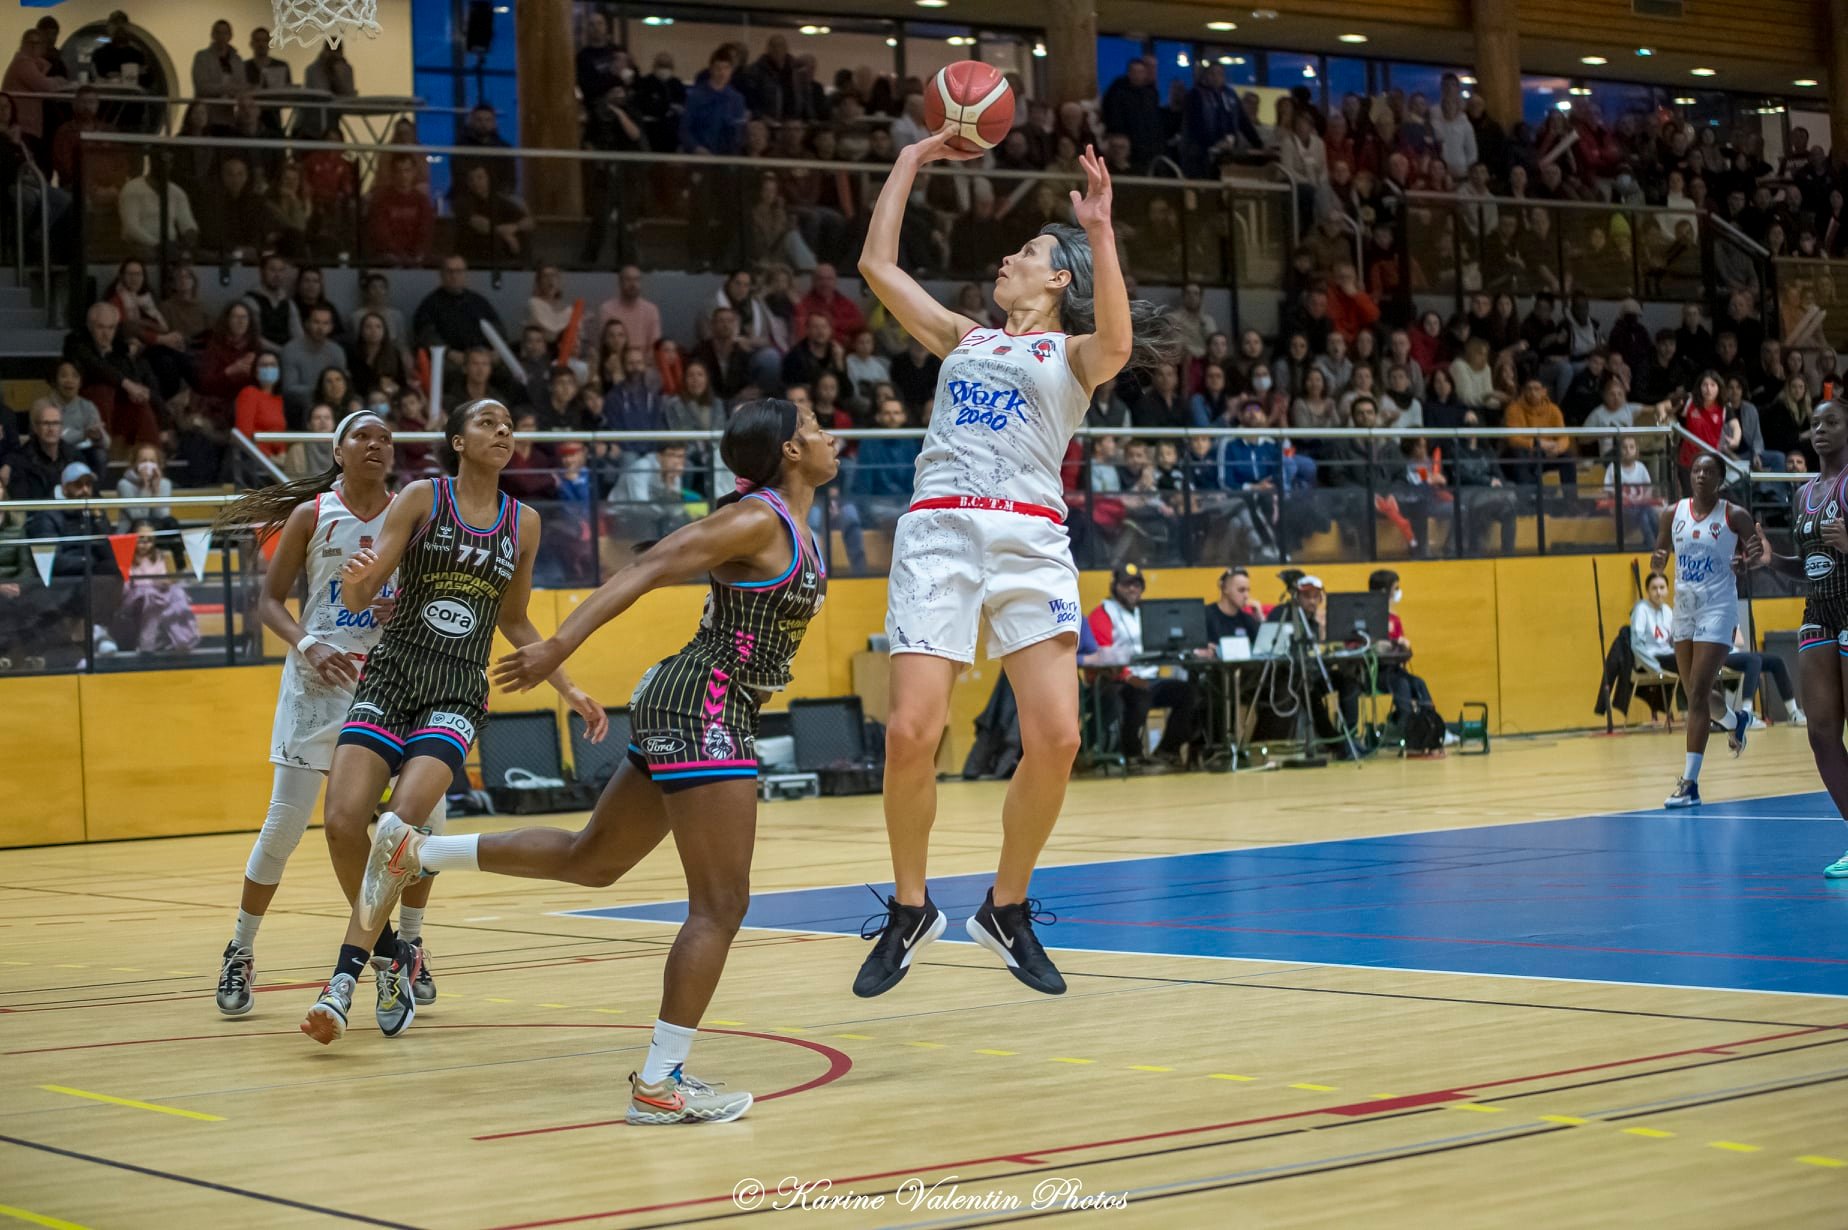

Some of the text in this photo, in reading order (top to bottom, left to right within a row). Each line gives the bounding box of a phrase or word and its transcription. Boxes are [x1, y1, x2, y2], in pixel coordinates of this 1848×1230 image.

[948, 380, 1028, 424] Work
[955, 406, 1008, 432] 2000
[456, 544, 491, 567] 77
[1678, 553, 1713, 573] Work
[422, 571, 499, 599] CHAMPAGNE
[434, 580, 485, 599] BASKET
[426, 605, 472, 629] cora
[447, 716, 472, 739] JOA
[646, 738, 676, 752] Ford
